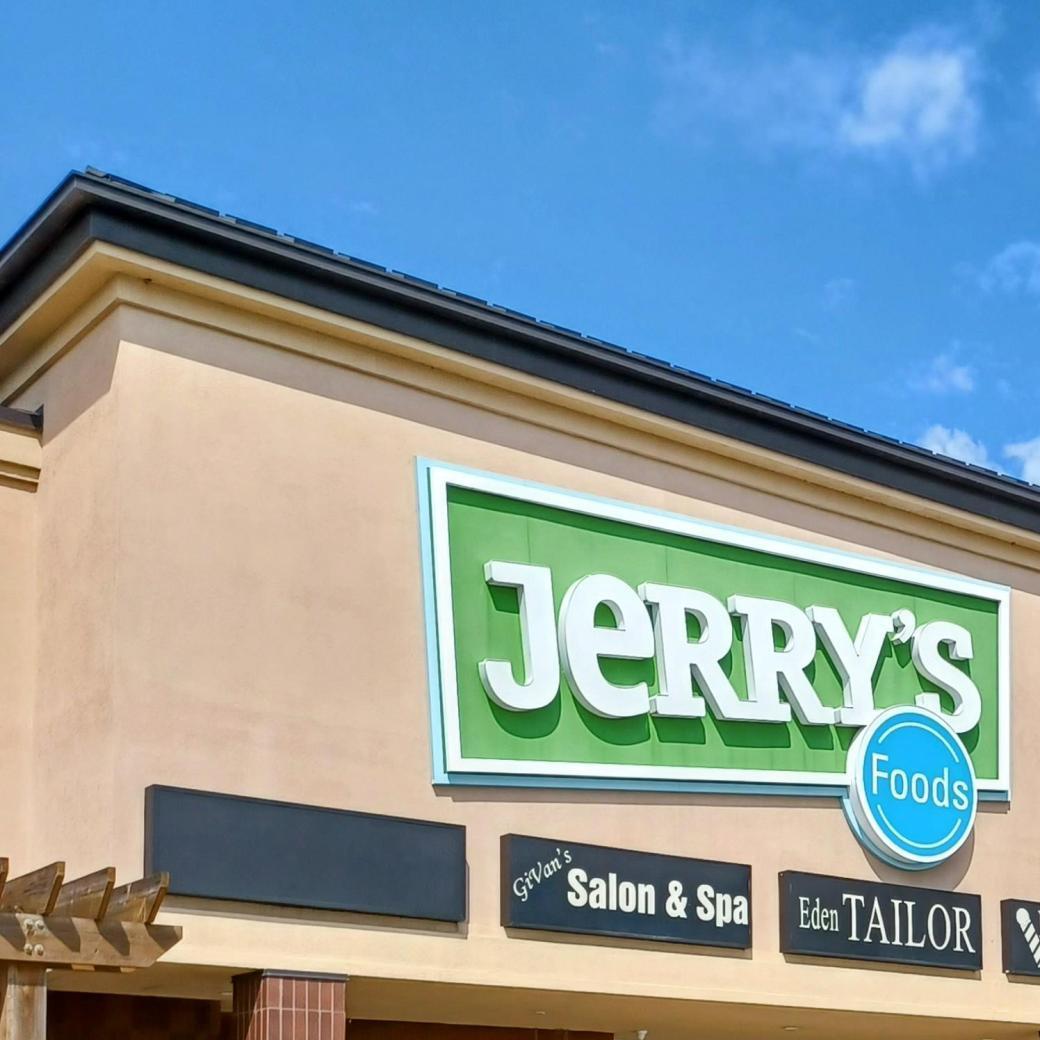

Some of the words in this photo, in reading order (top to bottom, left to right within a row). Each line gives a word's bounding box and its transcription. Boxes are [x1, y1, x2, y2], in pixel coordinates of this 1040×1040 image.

[872, 753, 969, 811] Foods
[512, 847, 573, 902] GiVan's
[567, 868, 656, 915] Salon
[665, 880, 688, 919] &
[696, 884, 749, 928] Spa
[798, 896, 840, 932] Eden
[842, 893, 977, 954] TAILOR
